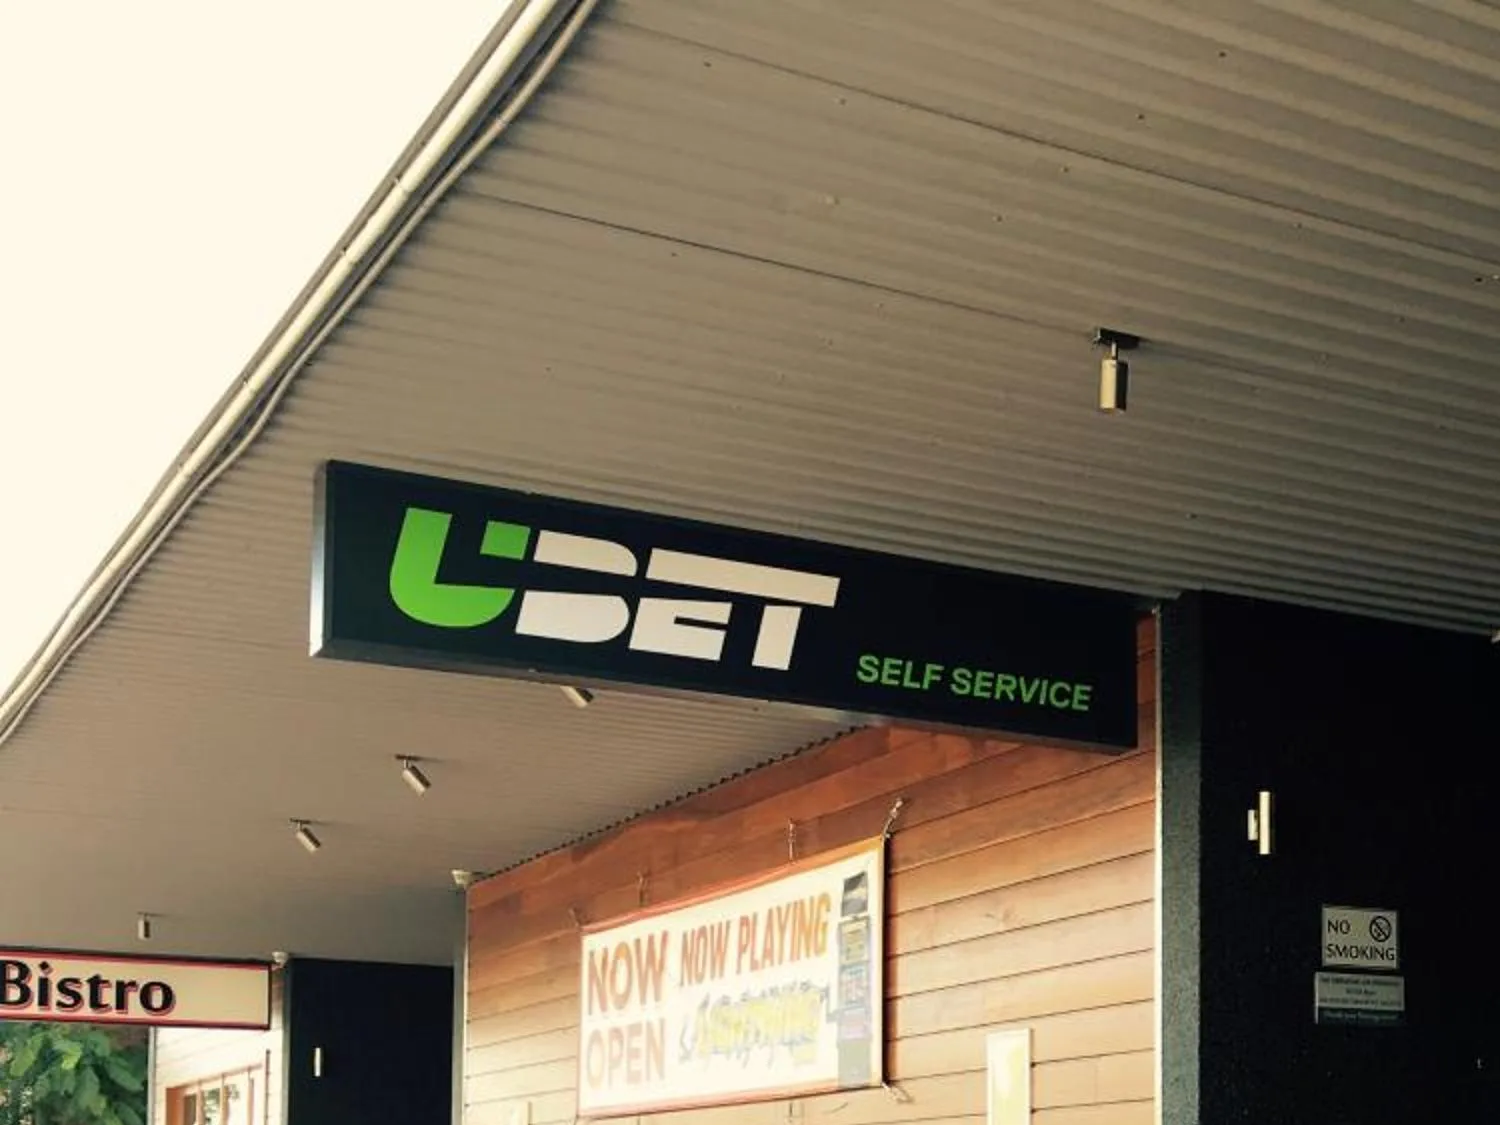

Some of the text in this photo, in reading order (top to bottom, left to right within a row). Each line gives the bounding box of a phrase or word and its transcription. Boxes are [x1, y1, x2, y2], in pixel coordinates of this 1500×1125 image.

[389, 507, 841, 671] UBET
[857, 655, 1093, 711] SELF SERVICE
[680, 892, 832, 987] NOW PLAYING
[1326, 944, 1395, 960] SMOKING
[1327, 919, 1351, 935] NO
[0, 959, 176, 1015] Bistro
[588, 929, 669, 1015] NOW
[587, 1018, 666, 1090] OPEN
